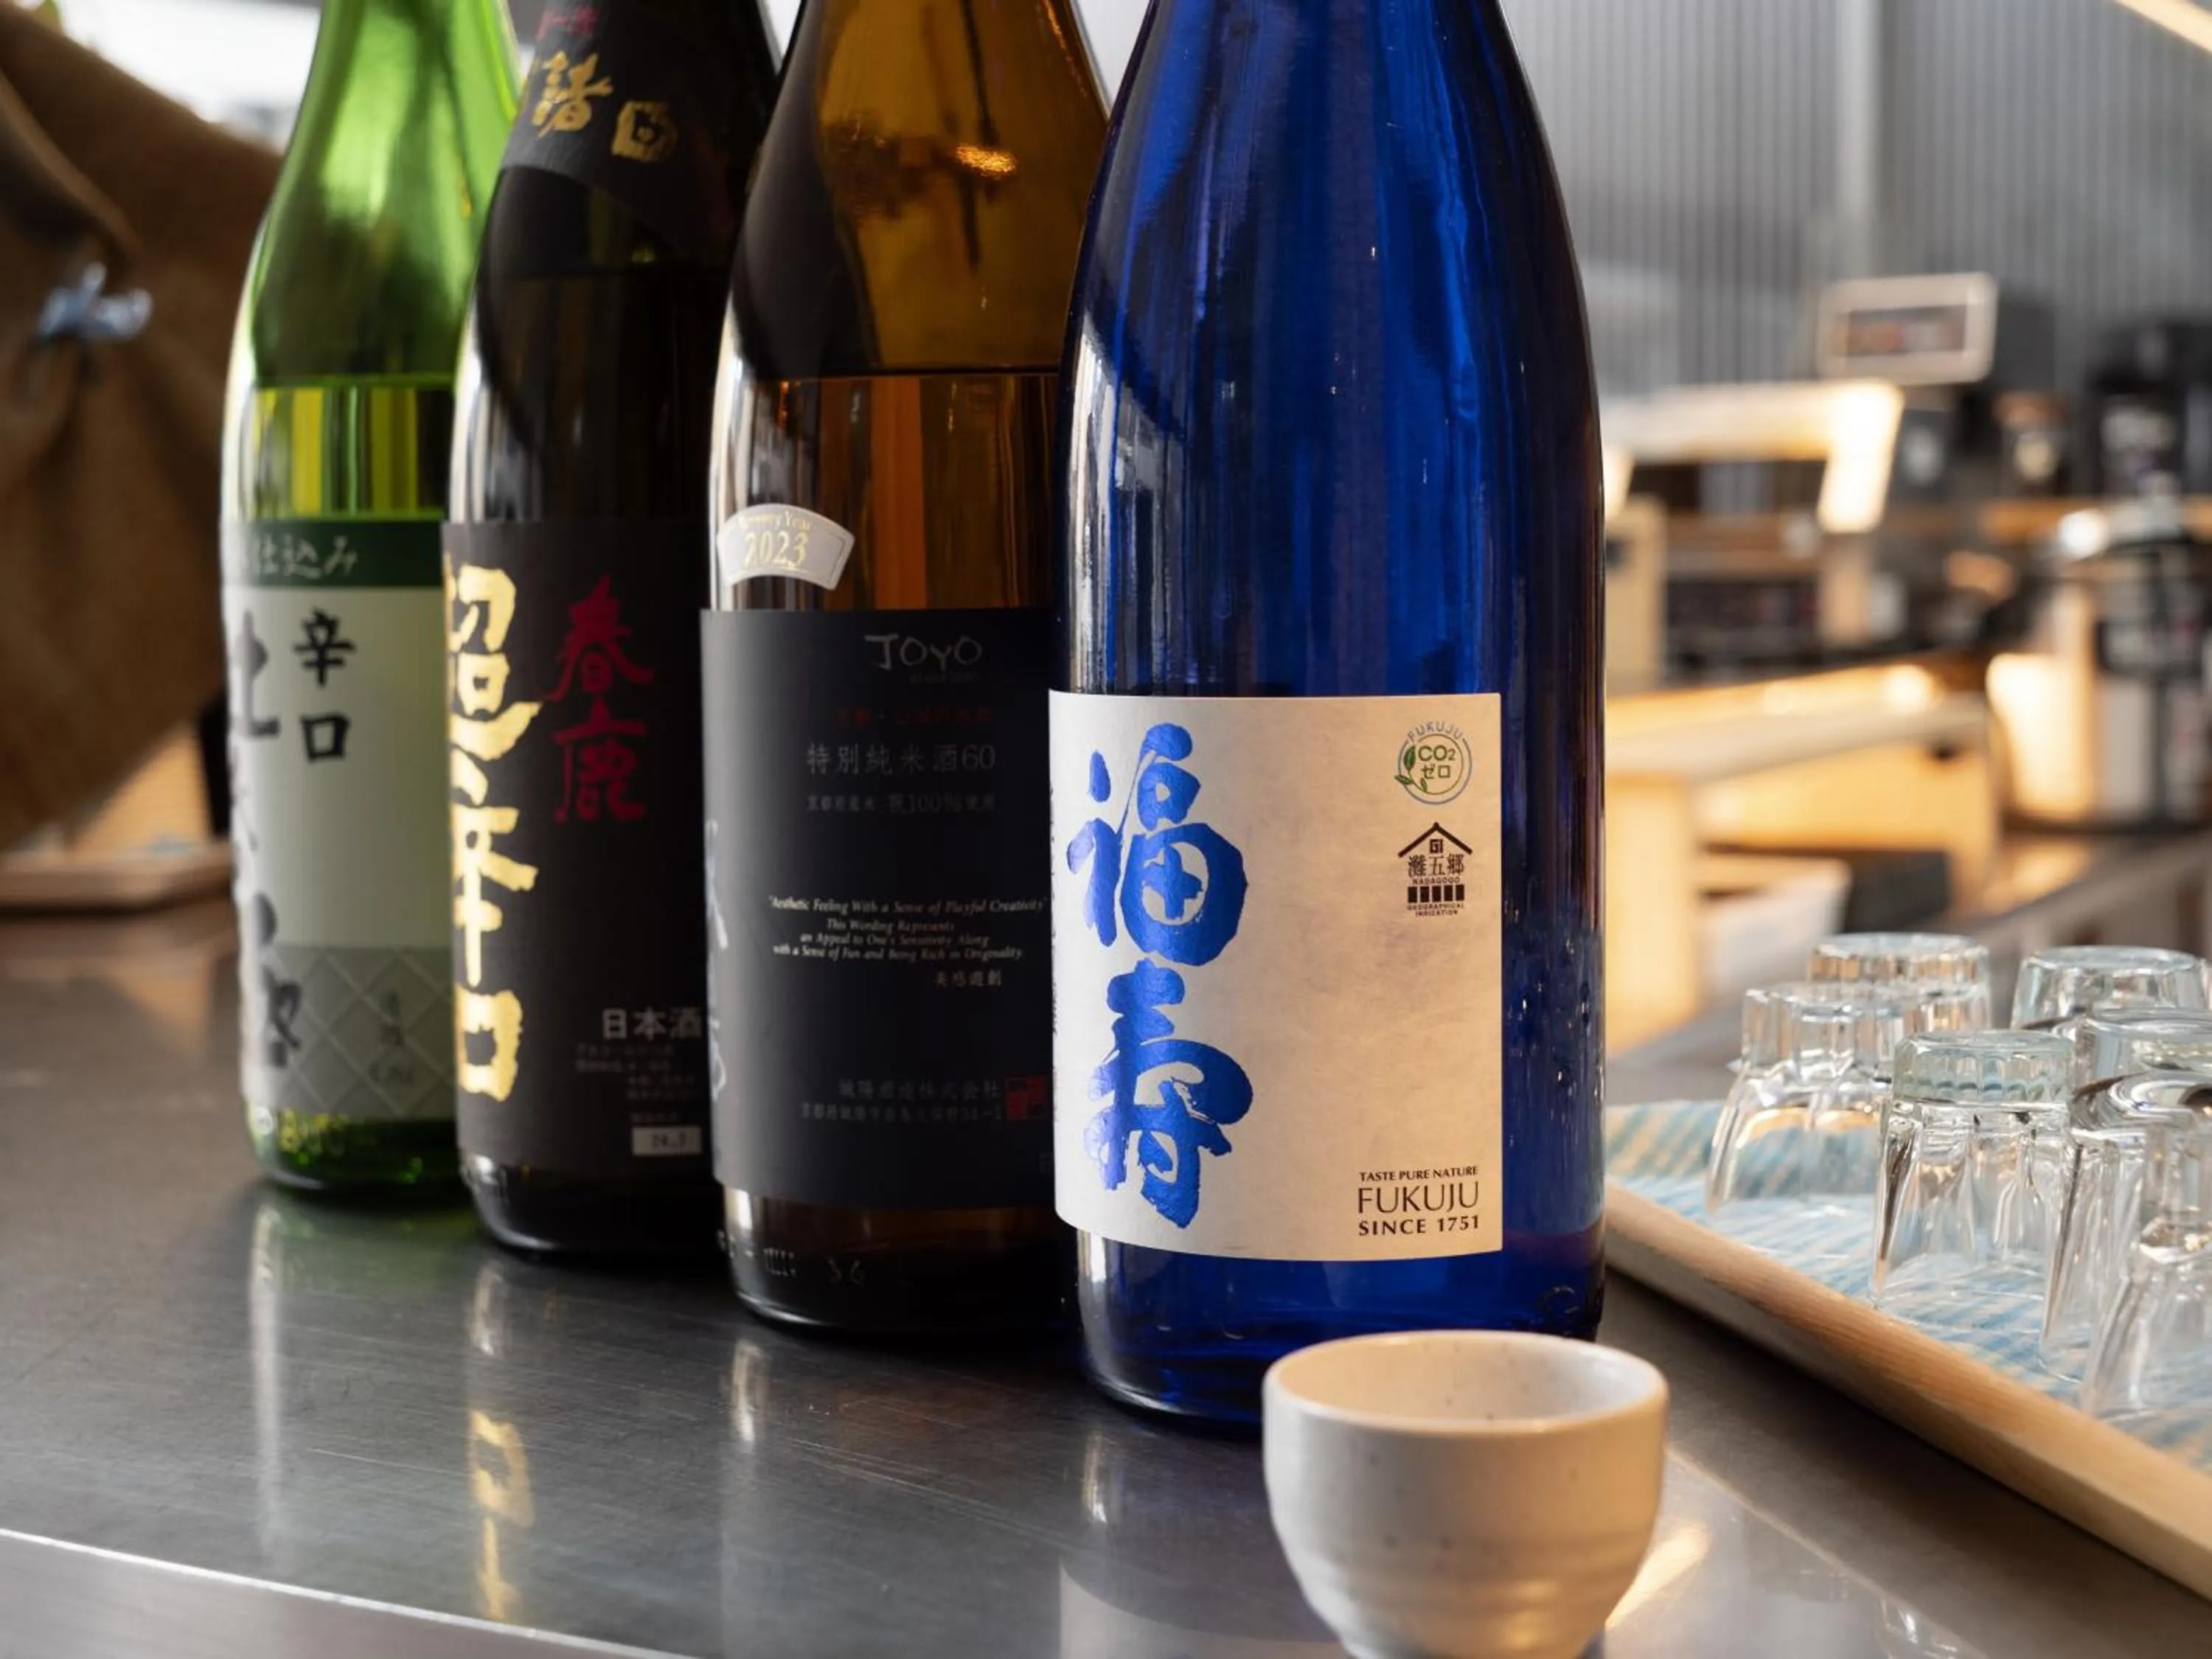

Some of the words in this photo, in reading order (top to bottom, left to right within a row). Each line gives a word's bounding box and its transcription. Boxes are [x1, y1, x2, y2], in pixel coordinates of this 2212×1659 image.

[743, 529, 809, 571] 2023
[294, 607, 356, 765] 辛口
[1408, 720, 1463, 742] FUKUJU
[1422, 764, 1451, 779] ゼロ
[1412, 876, 1461, 885] NADAGOGO
[602, 1006, 703, 1040] 日本酒
[1359, 1171, 1396, 1181] TASTE
[1399, 1169, 1430, 1180] PURE
[1433, 1166, 1478, 1179] NATURE
[1358, 1181, 1479, 1214] FUKUJU
[1358, 1219, 1427, 1237] SINCE
[1437, 1215, 1479, 1232] 1751
